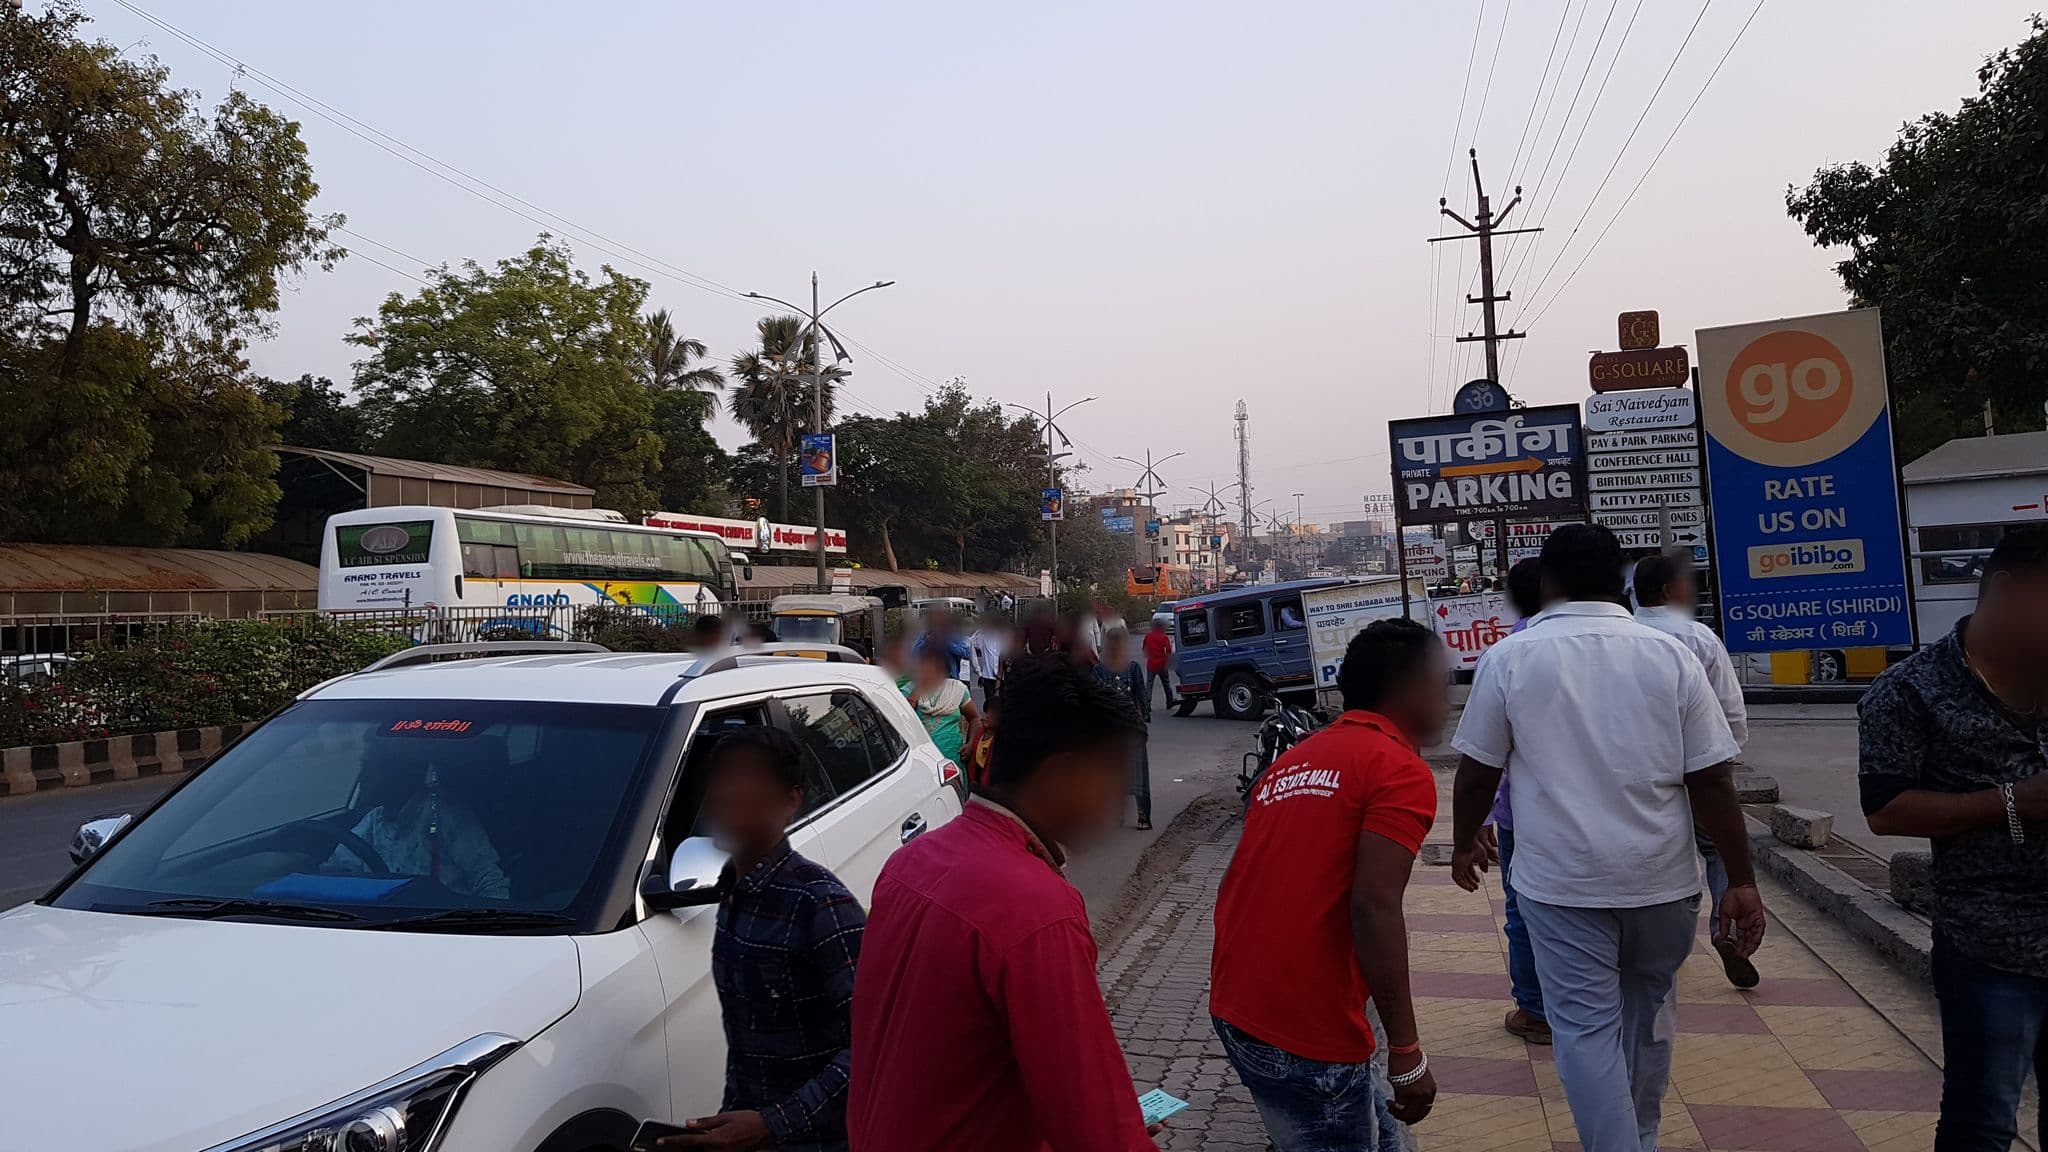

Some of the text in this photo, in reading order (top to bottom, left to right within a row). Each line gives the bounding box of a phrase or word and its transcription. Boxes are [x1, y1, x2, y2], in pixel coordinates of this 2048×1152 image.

[1593, 358, 1686, 380] G-SQUARE
[1740, 356, 1841, 424] go
[1590, 395, 1689, 414] Sai Naivedyam
[1608, 413, 1679, 426] Restaurant
[1591, 432, 1694, 449] PAY & PARK PARKING
[1594, 452, 1693, 468] CONFERENCE HALL
[1401, 468, 1431, 479] PRIVATE
[1596, 472, 1693, 488] BIRTHDAY PARTIES
[1406, 471, 1572, 510] PARKING
[1764, 475, 1835, 501] RATE
[1600, 492, 1691, 507] KITTY PARTIES
[1597, 511, 1698, 527] WEDDING CERONIES
[1758, 507, 1847, 534] US ON
[1514, 524, 1552, 537] RAJA
[1616, 533, 1640, 545] AST
[374, 552, 426, 565] SUSPENSION
[563, 548, 662, 568] www.theanandtravels.com
[1759, 544, 1853, 573] goibibo
[1831, 562, 1854, 570] .com
[344, 572, 377, 583] ANAND
[379, 571, 421, 580] TRAVELS
[1406, 567, 1445, 577] ARKING
[507, 594, 569, 611] ANAND
[1309, 606, 1324, 614] WAY
[1337, 602, 1353, 610] SHRI
[1354, 599, 1384, 608] SAIBABA
[1729, 595, 1902, 621] G SQUARE (SHIRDI)
[1746, 626, 1765, 641] जी
